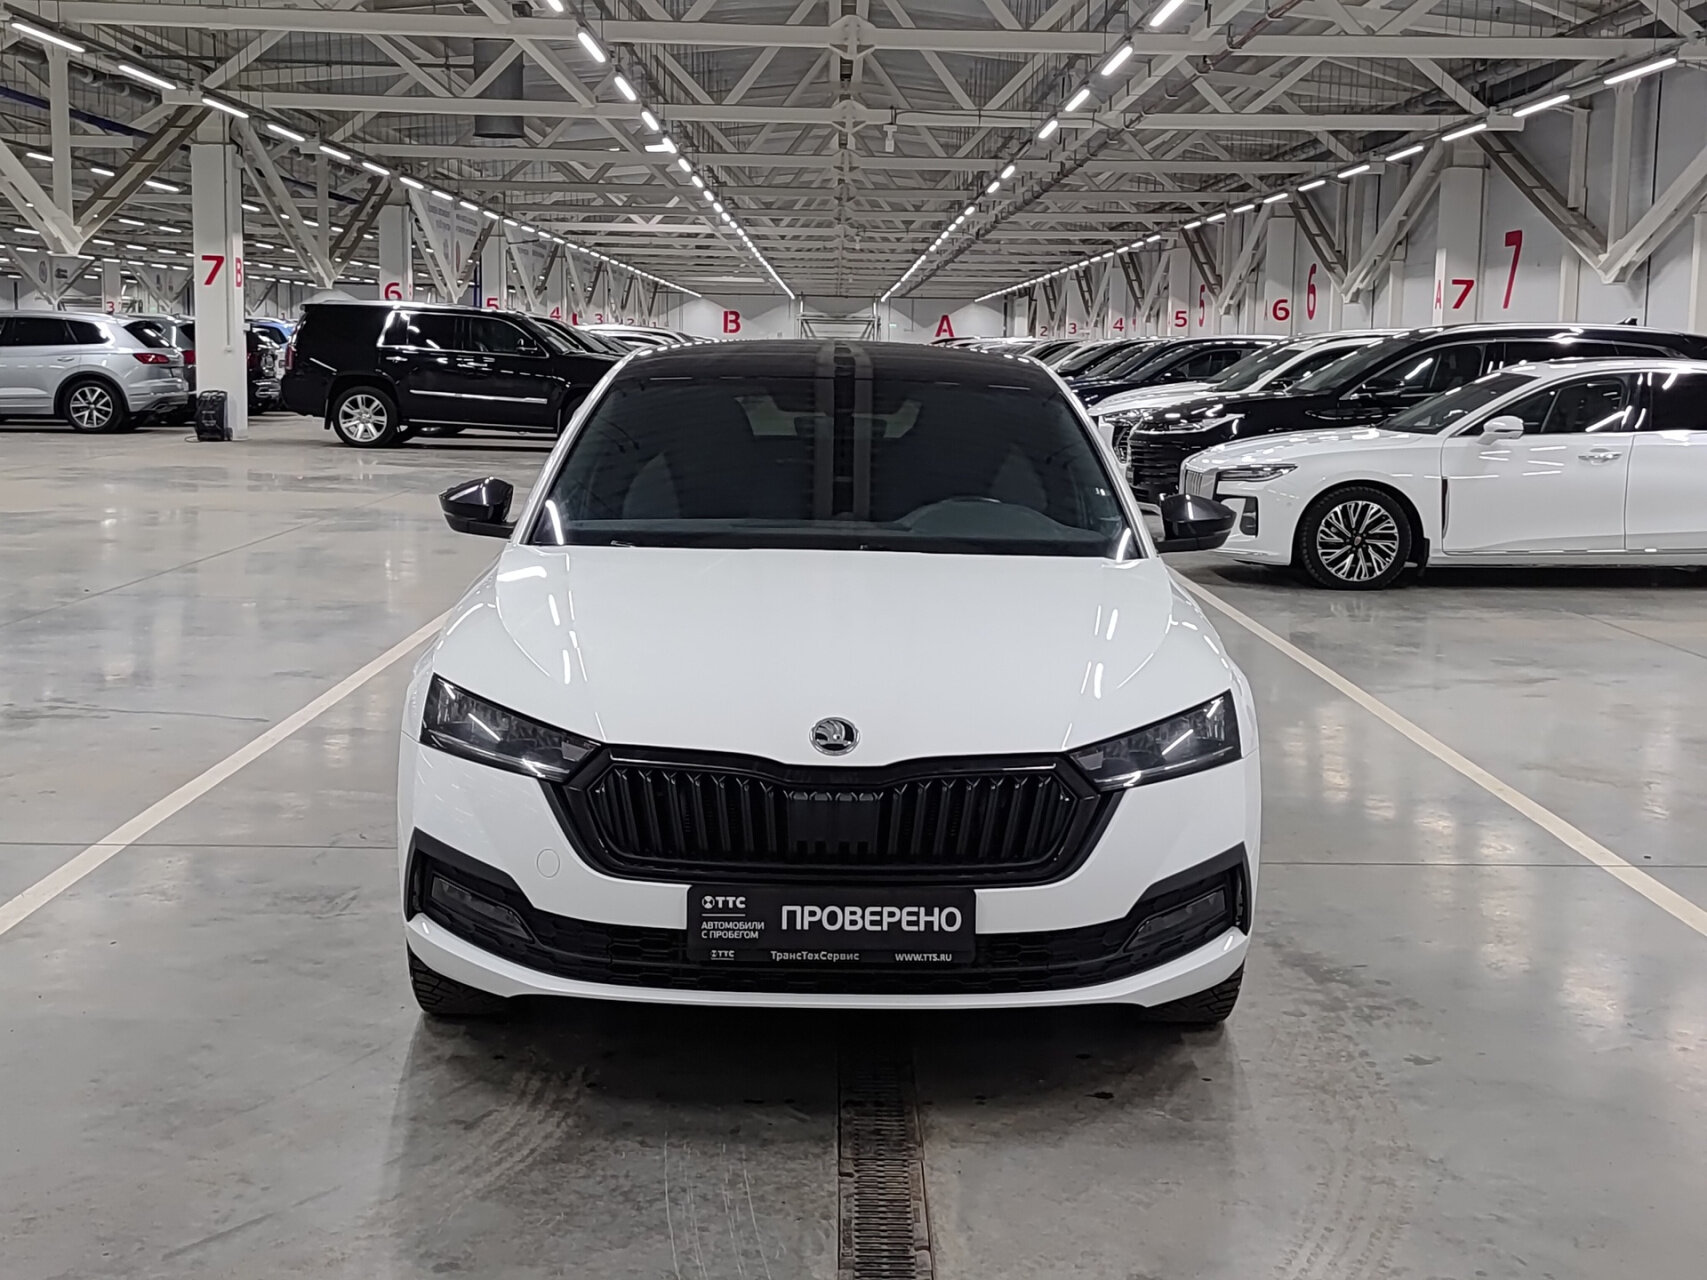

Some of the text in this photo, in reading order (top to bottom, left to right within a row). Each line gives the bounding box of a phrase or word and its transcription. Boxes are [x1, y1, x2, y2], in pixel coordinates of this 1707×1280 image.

[202, 255, 225, 285] 7
[1502, 229, 1522, 309] 7
[385, 282, 402, 300] 6
[1307, 263, 1317, 320] 6
[1435, 279, 1442, 309] A
[1452, 279, 1475, 309] 7
[106, 301, 115, 314] 3
[487, 298, 499, 309] 5
[1272, 299, 1290, 321] 6
[550, 306, 561, 320] 4
[594, 313, 604, 324] 3
[1174, 310, 1188, 328] 5
[723, 310, 741, 333] B
[935, 315, 955, 337] A
[1068, 322, 1077, 335] 3
[1112, 317, 1124, 332] 4
[1039, 326, 1048, 337] 2
[715, 896, 746, 909] ТТС
[701, 921, 765, 930] АВТОМОБИЛИ
[781, 905, 962, 932] ПРОВЕРЕНО
[701, 930, 759, 939] С ПРОБЕГОМ
[770, 950, 860, 962] ТрансТехСервис
[895, 953, 952, 962] WWW.TTS.RU
